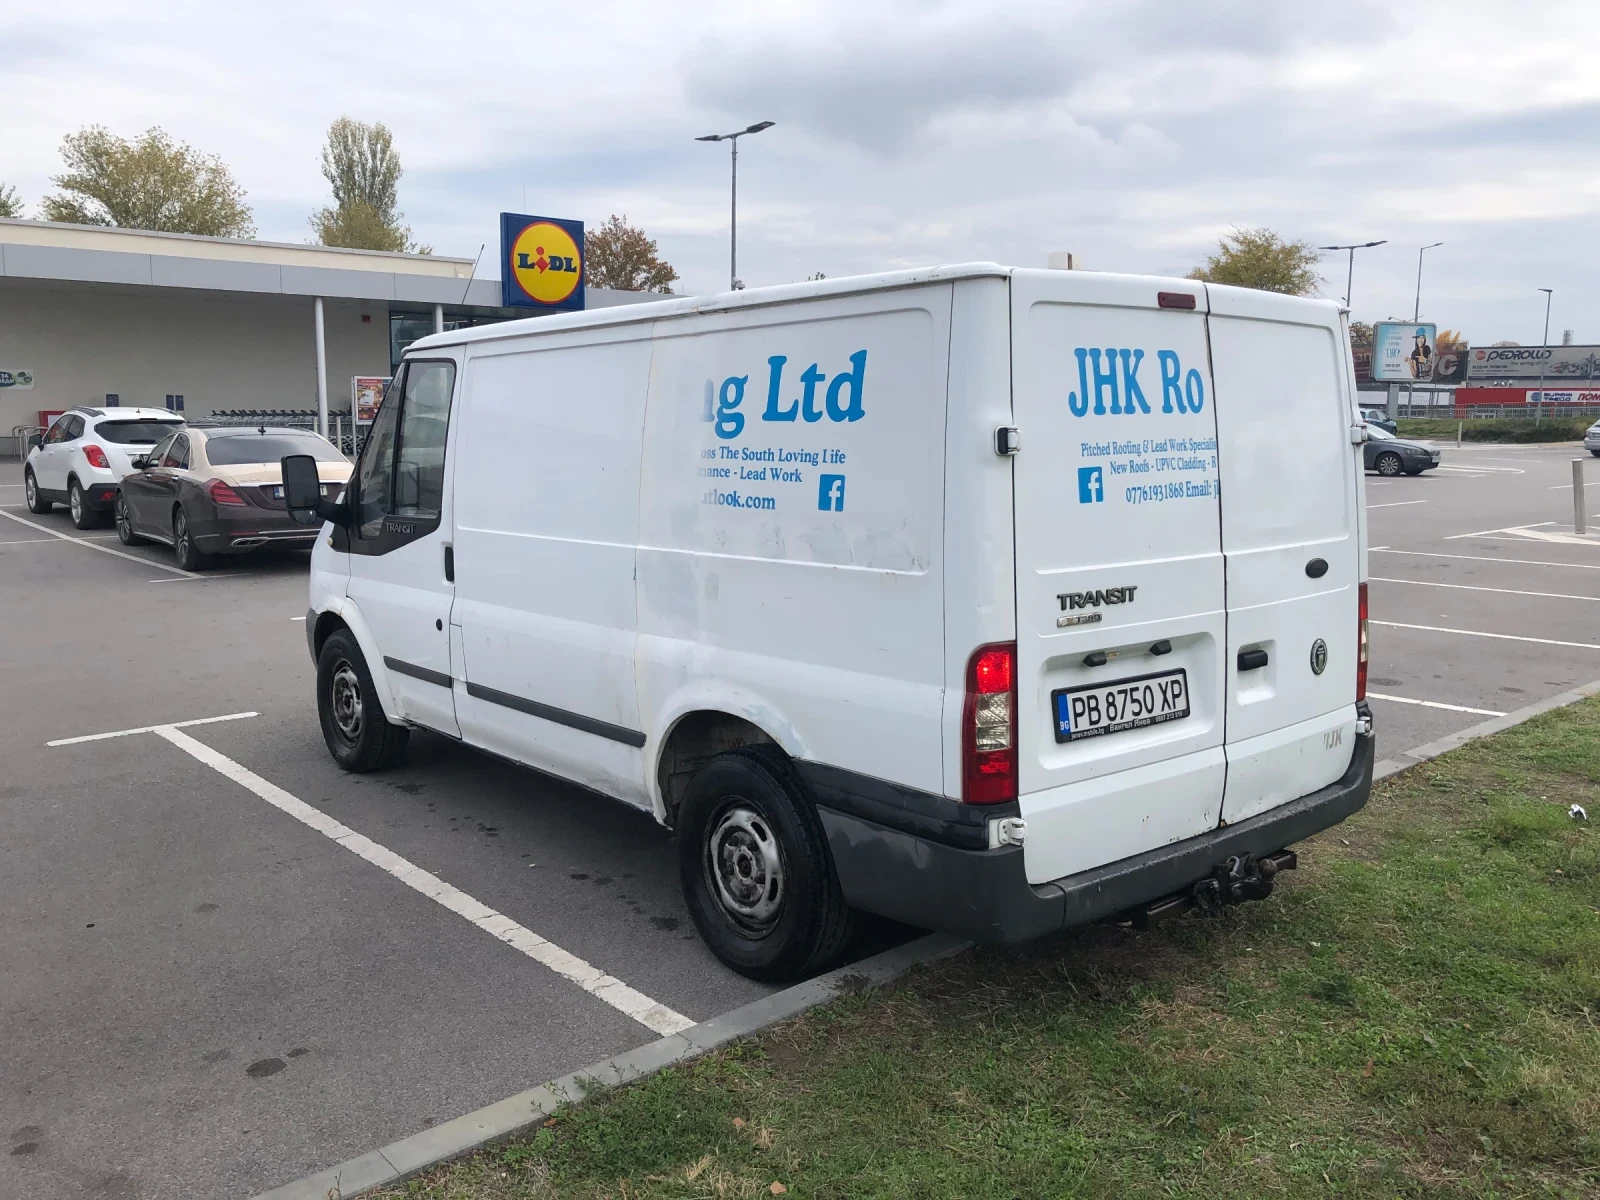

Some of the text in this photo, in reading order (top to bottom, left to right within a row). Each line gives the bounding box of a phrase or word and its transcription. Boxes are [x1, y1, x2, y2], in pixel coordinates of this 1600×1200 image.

[1486, 349, 1552, 362] PEDROLLO
[761, 349, 867, 423] Ltd
[1068, 347, 1204, 418] JHK Ro
[719, 446, 740, 460] The
[741, 447, 775, 462] South
[778, 449, 819, 466] Loving
[1081, 441, 1111, 457] Pitched
[1112, 440, 1142, 457] Roofing
[1142, 440, 1150, 453] &
[1150, 438, 1168, 453] Lead
[1168, 439, 1188, 452] Work
[740, 466, 766, 481] Lead
[770, 467, 803, 483] Work
[1110, 461, 1128, 475] New
[1129, 459, 1150, 474] Roofs
[1155, 458, 1176, 471] UPVC
[1176, 455, 1207, 472] Cladding
[1125, 481, 1184, 504] 07761931868
[1185, 480, 1212, 498] Email:
[386, 522, 416, 534] TRANSIT
[1057, 585, 1138, 611] TRANSIT
[1072, 679, 1183, 729] PB 8750 XP
[1060, 720, 1070, 731] BG
[1109, 718, 1151, 732] Вангел Янев
